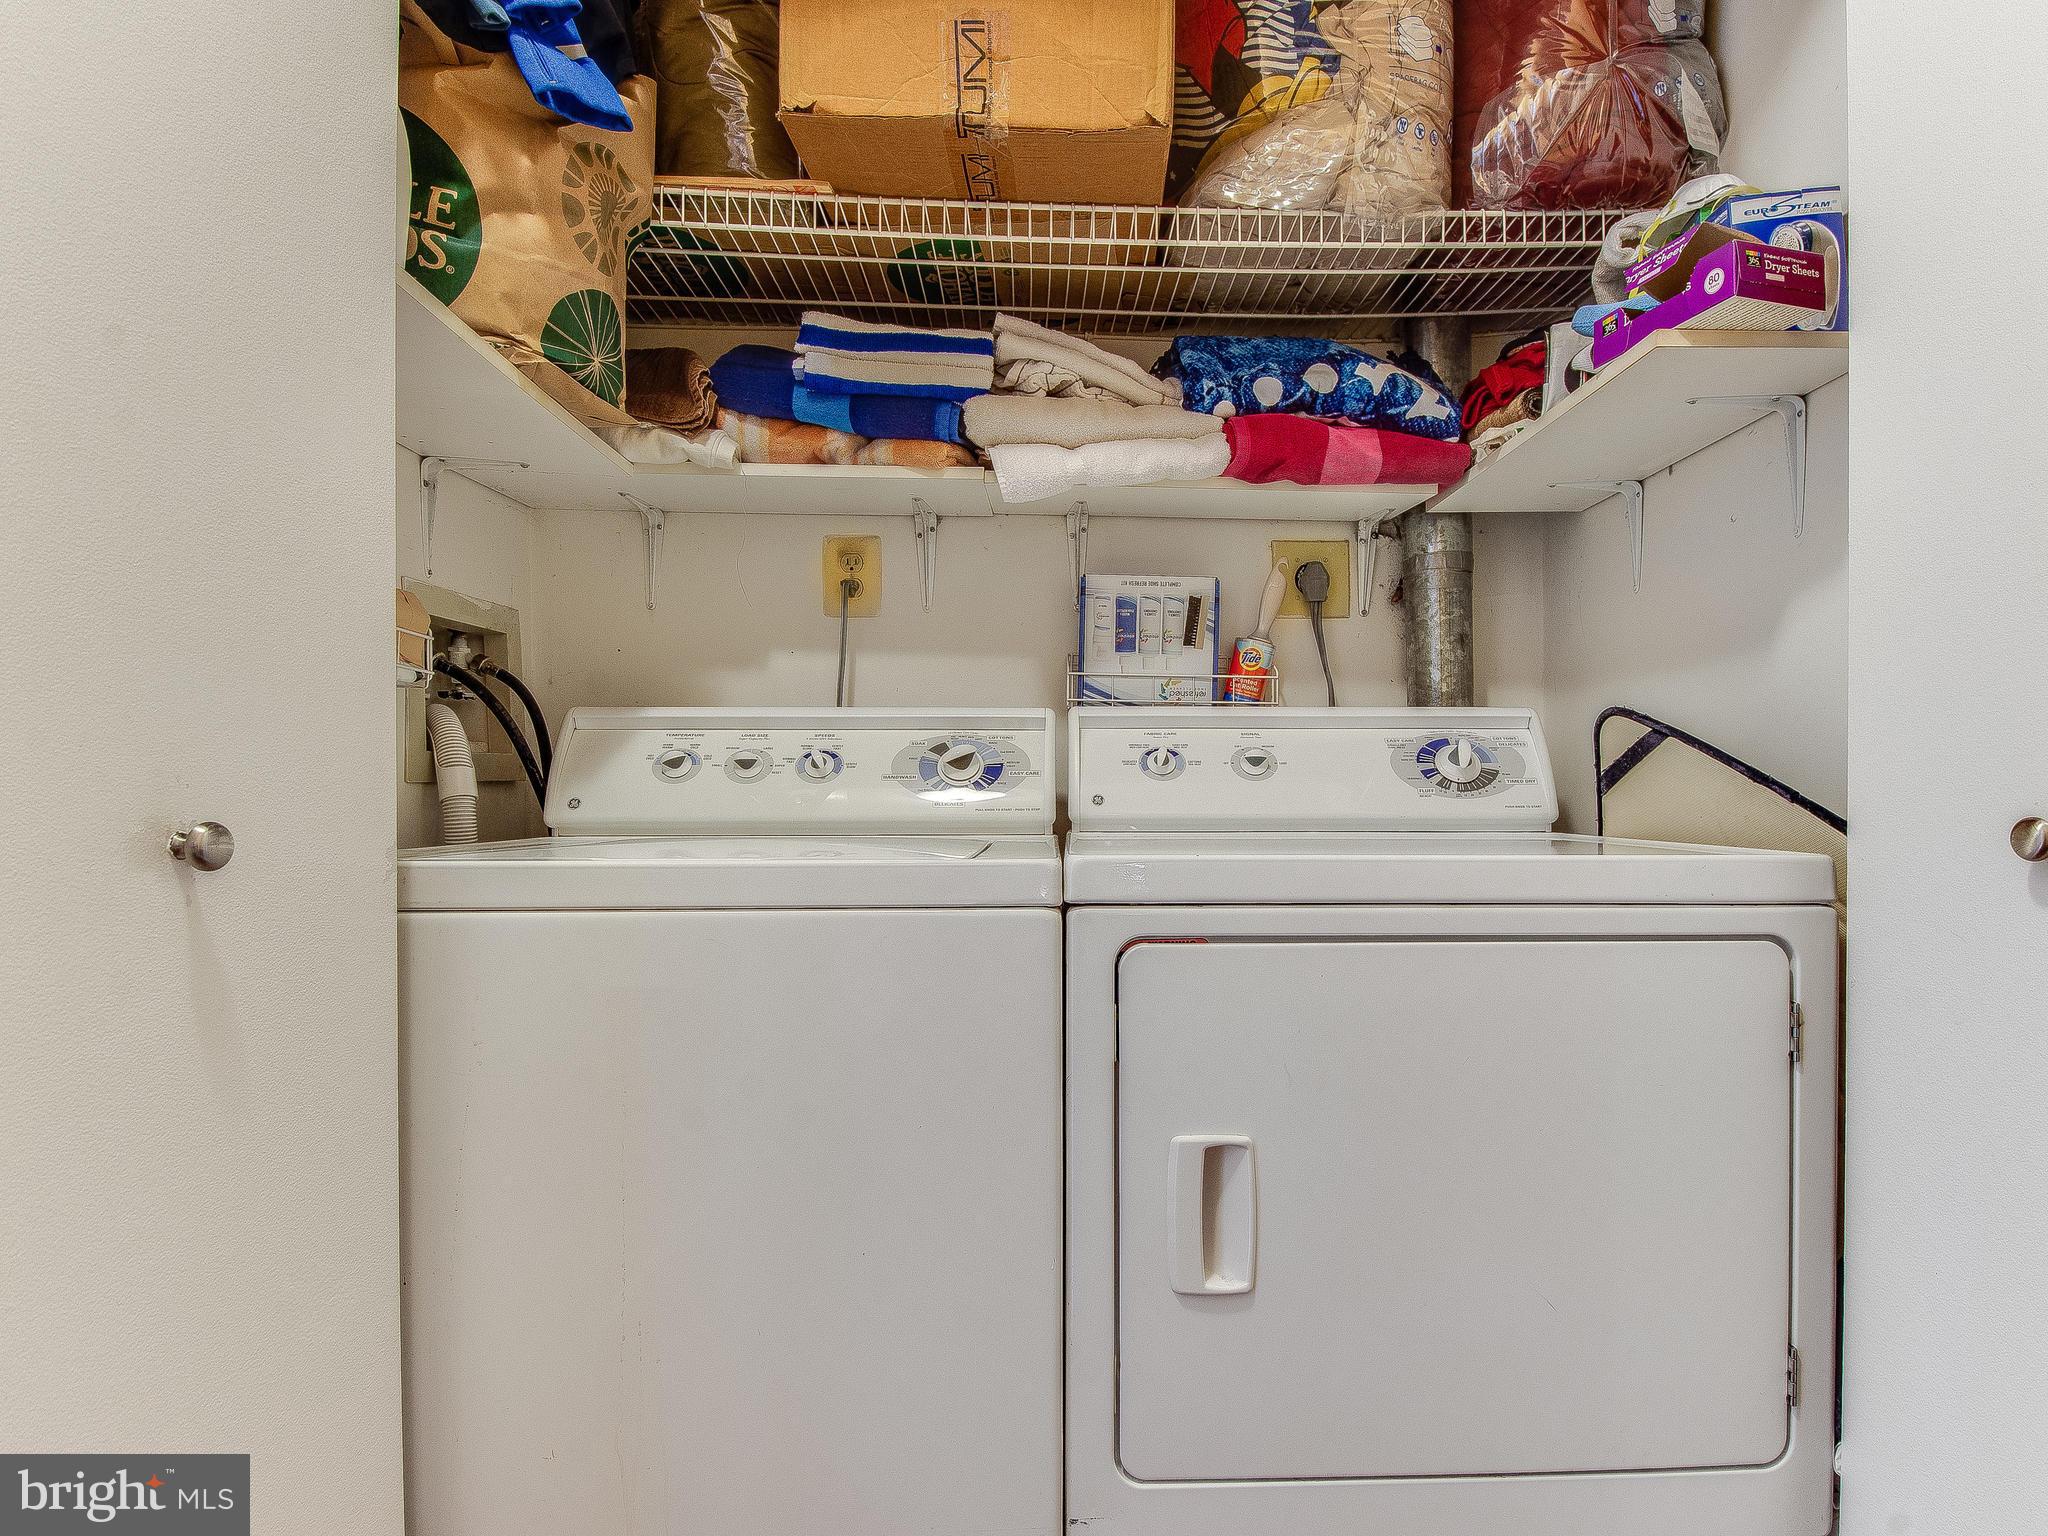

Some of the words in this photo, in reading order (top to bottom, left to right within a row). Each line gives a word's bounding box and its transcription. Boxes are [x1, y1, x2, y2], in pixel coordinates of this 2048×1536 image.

[953, 19, 988, 138] TUMI
[1764, 259, 1791, 274] Dryer
[1791, 263, 1820, 278] Sheets
[1708, 272, 1720, 286] 80
[1241, 651, 1262, 664] Tide
[1241, 683, 1260, 693] Roller
